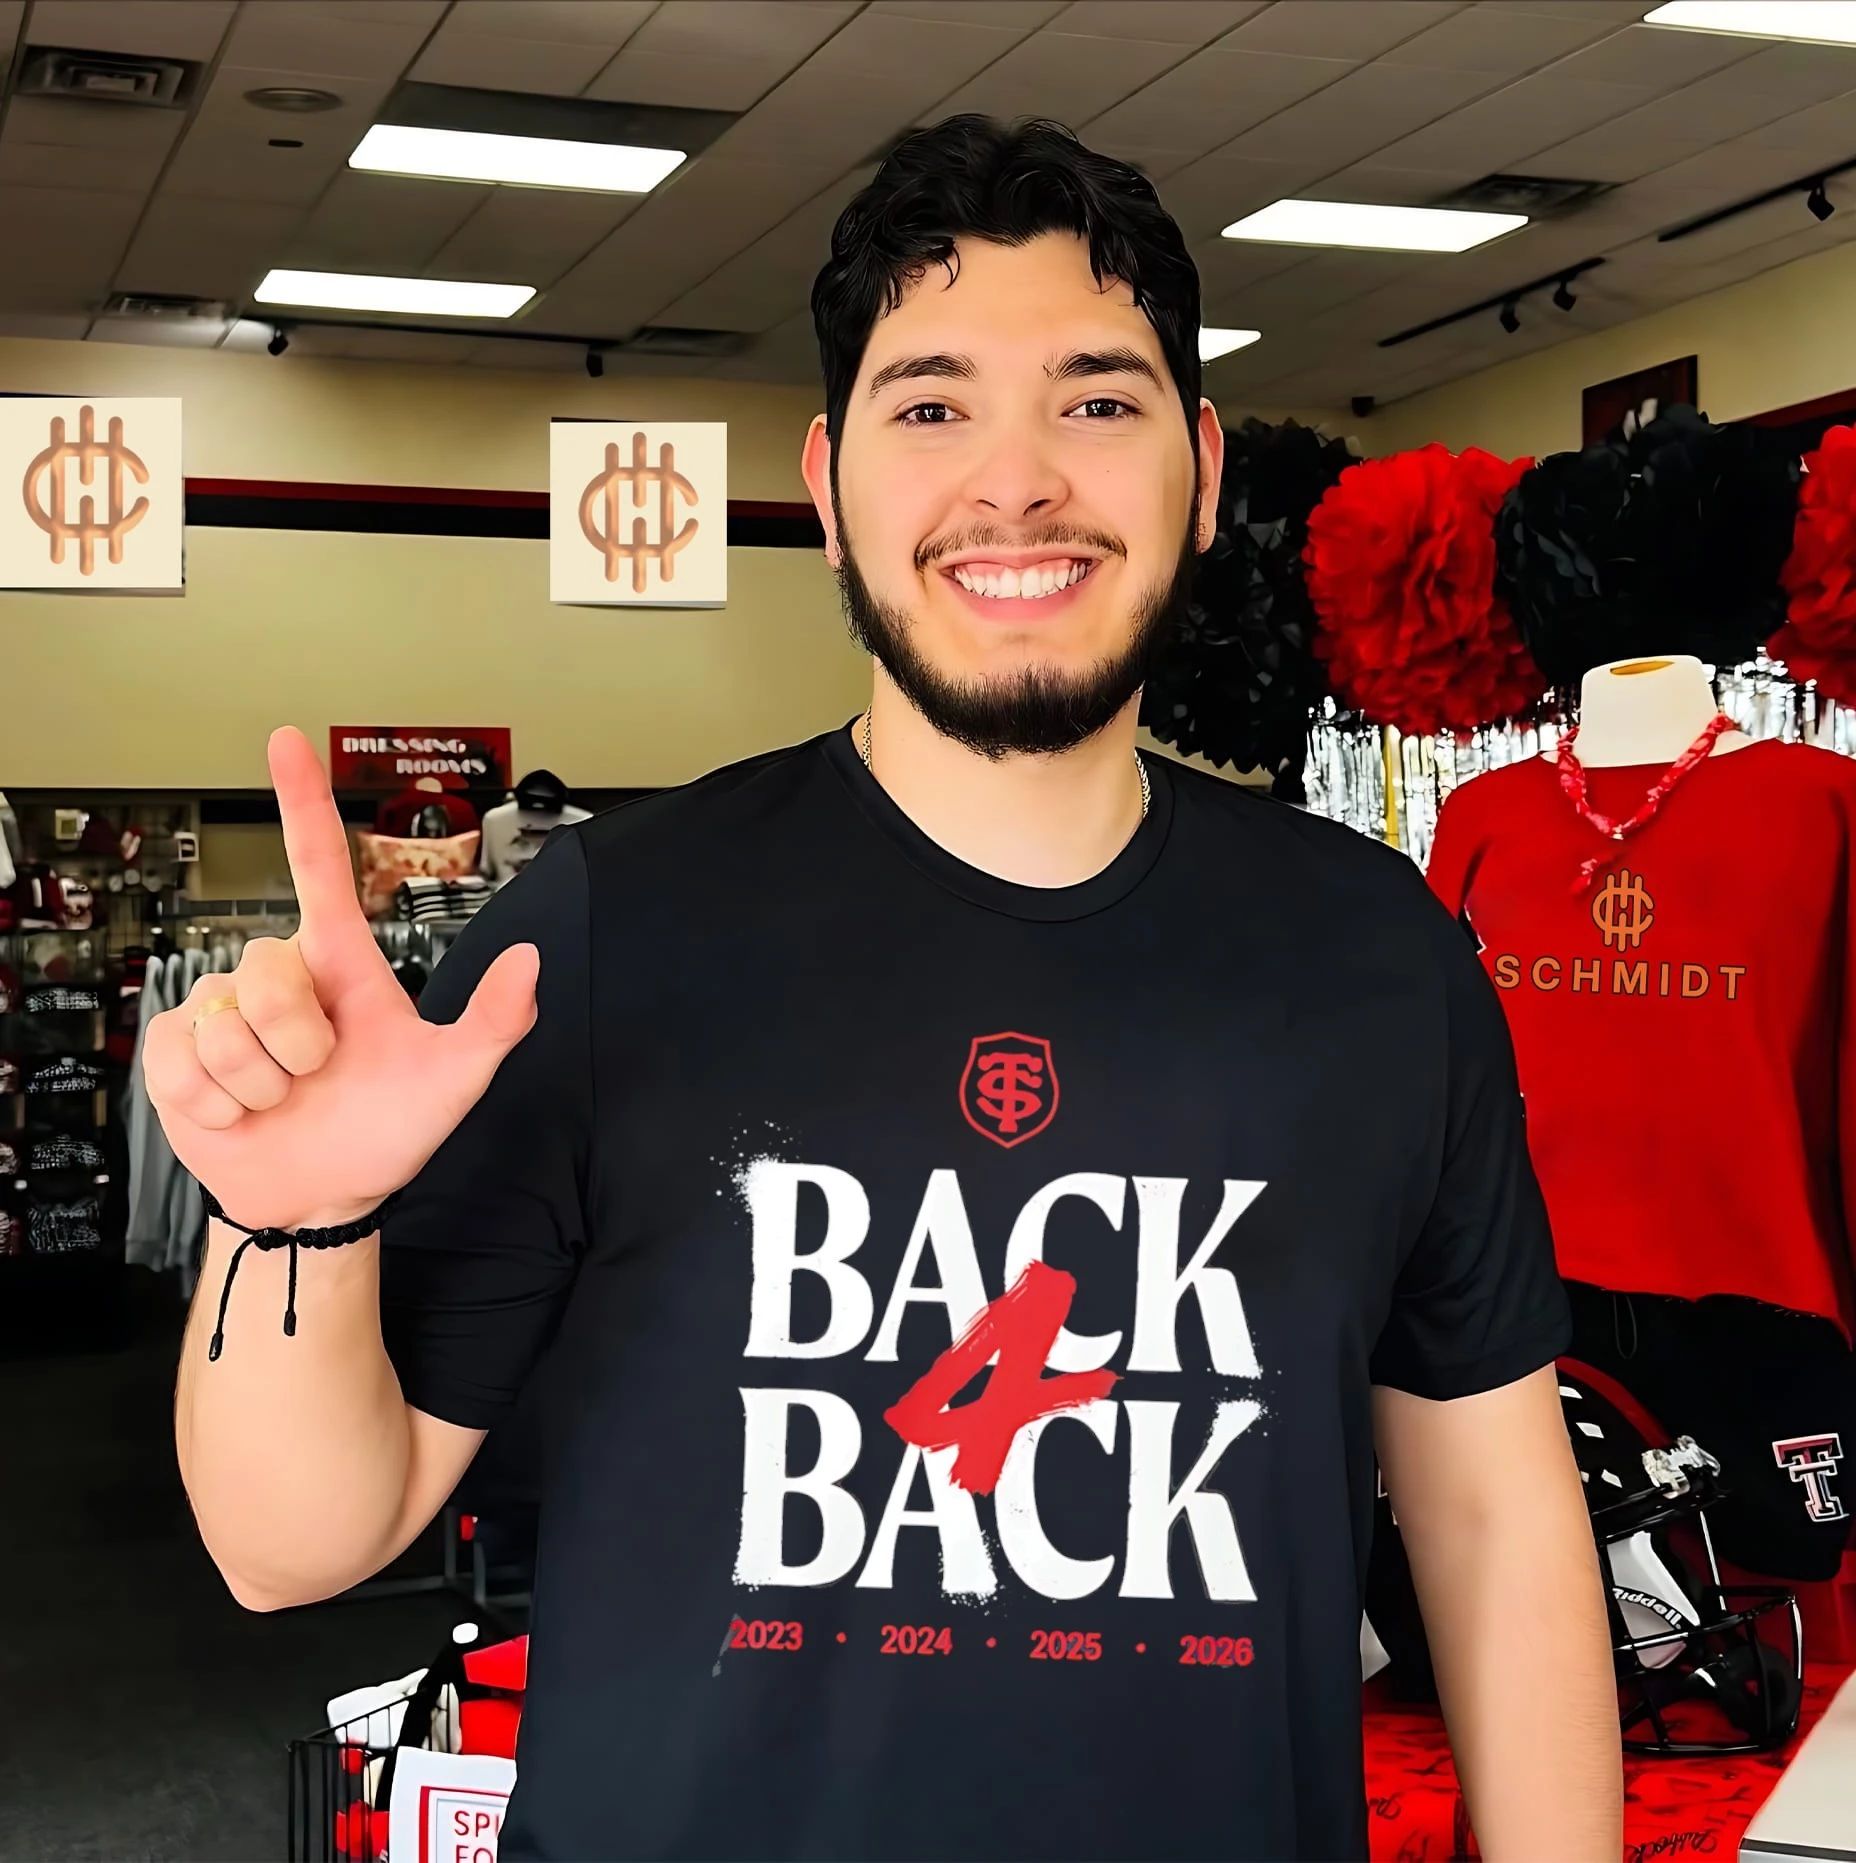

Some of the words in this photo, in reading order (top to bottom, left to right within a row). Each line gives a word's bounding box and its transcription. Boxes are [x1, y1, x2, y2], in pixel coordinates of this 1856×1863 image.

[396, 758, 487, 775] ROOMS
[1494, 954, 1747, 1000] SCHMIDT
[738, 1158, 1268, 1379] BACK
[883, 1259, 1121, 1497] 4
[732, 1387, 1262, 1604] BACK
[730, 1620, 803, 1651] 2023
[880, 1625, 953, 1656] 2024
[1030, 1630, 1103, 1661] 2025
[1179, 1635, 1254, 1666] 2026
